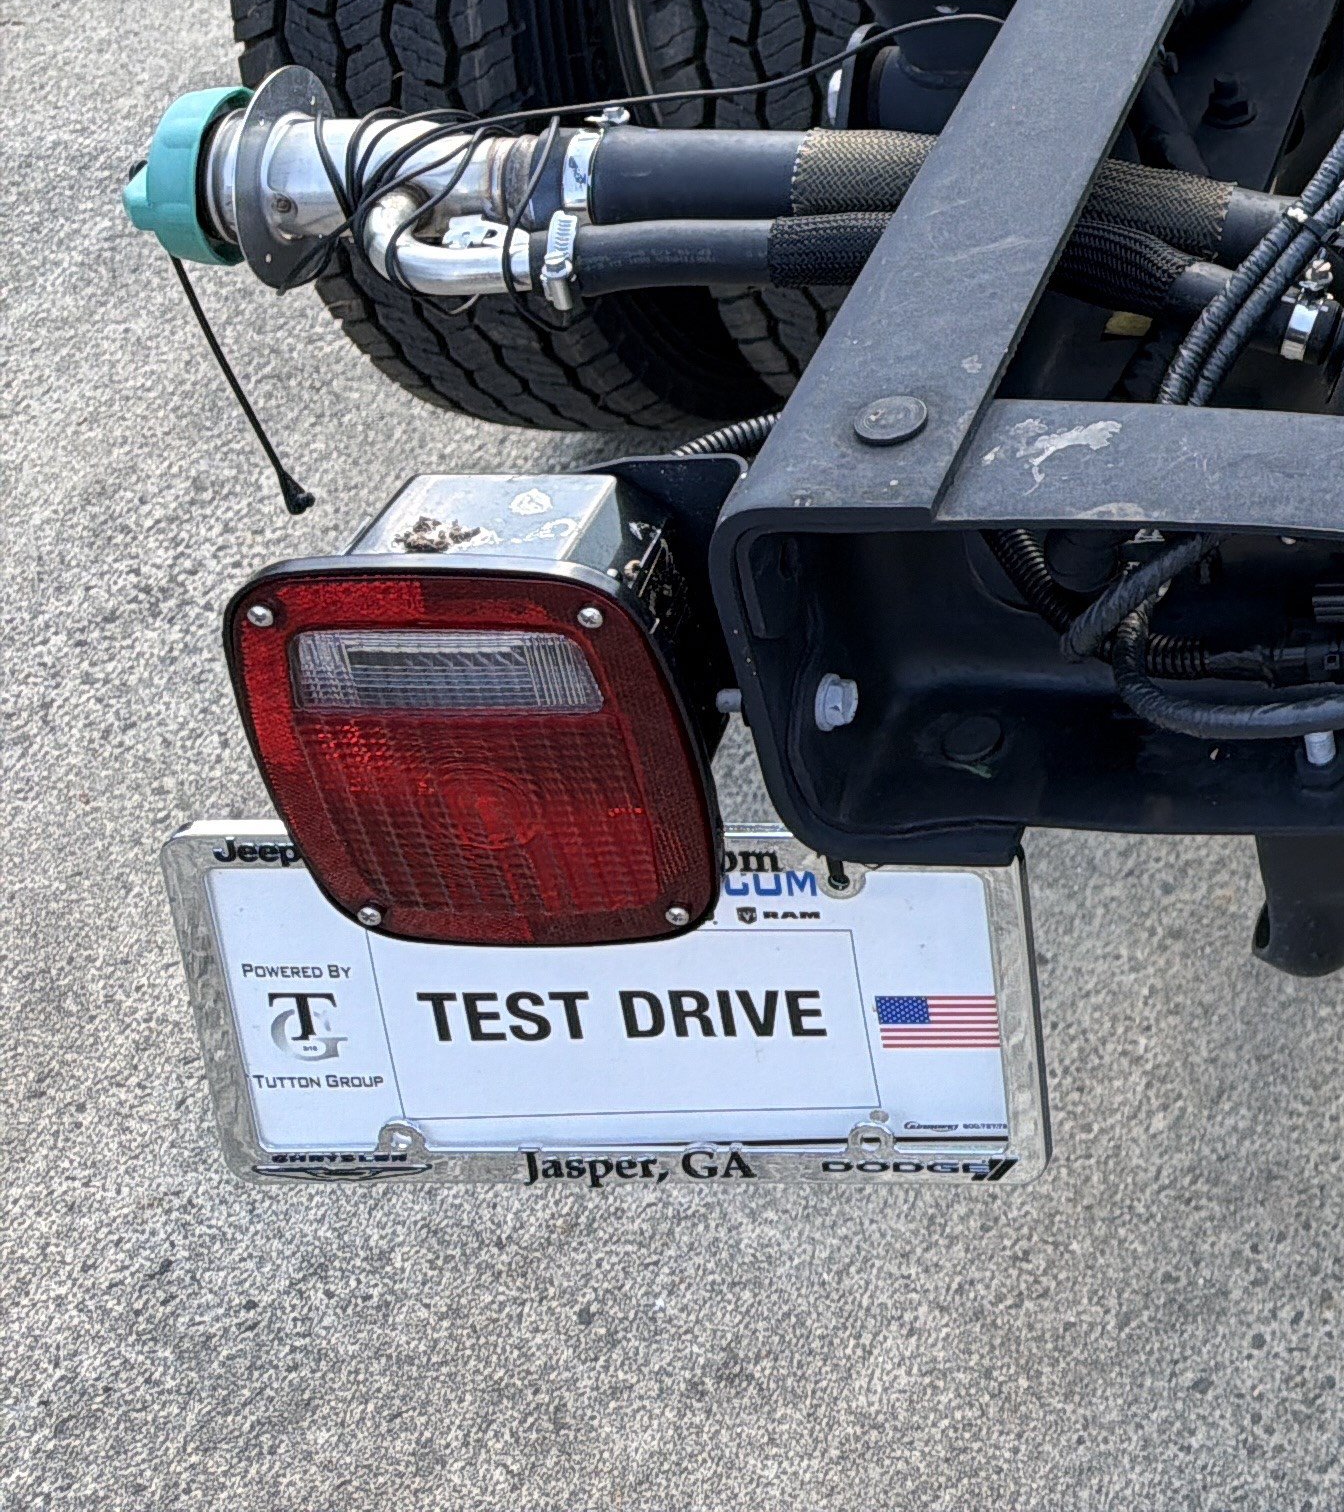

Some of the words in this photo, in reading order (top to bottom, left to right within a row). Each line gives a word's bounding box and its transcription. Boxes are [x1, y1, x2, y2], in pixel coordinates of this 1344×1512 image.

[212, 837, 300, 867] Jeep
[762, 910, 821, 920] RAM
[241, 963, 324, 979] POWERED
[416, 990, 590, 1042] TEST
[618, 989, 828, 1039] DRIVE
[252, 1074, 321, 1089] TUTTON
[325, 1074, 384, 1088] GROUP
[271, 1152, 408, 1164] CHRYSLER
[519, 1144, 670, 1188] Jasper,
[681, 1144, 758, 1180] GA
[821, 1159, 992, 1175] DODGE
